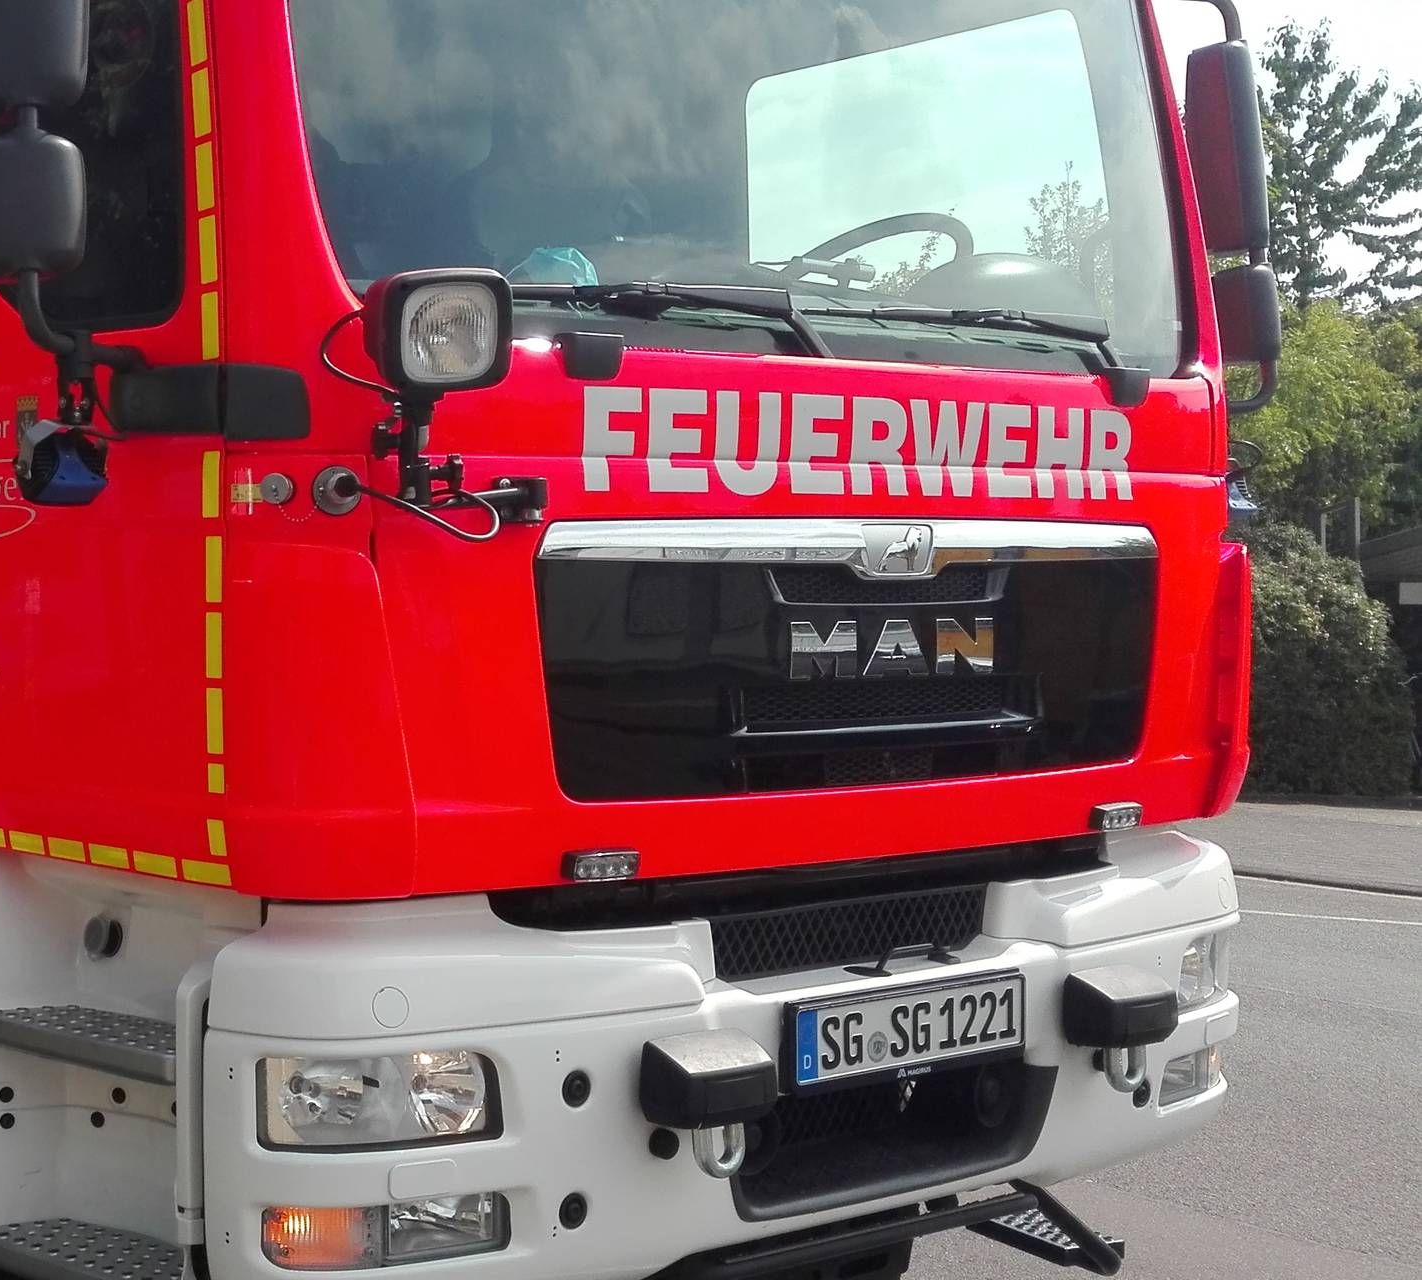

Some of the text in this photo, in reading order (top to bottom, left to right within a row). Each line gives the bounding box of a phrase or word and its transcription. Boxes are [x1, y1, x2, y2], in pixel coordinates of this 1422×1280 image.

[582, 386, 1133, 500] FEUERWEHR
[788, 616, 995, 680] MAN
[803, 1055, 811, 1070] D
[821, 988, 1016, 1070] SG SG 1221
